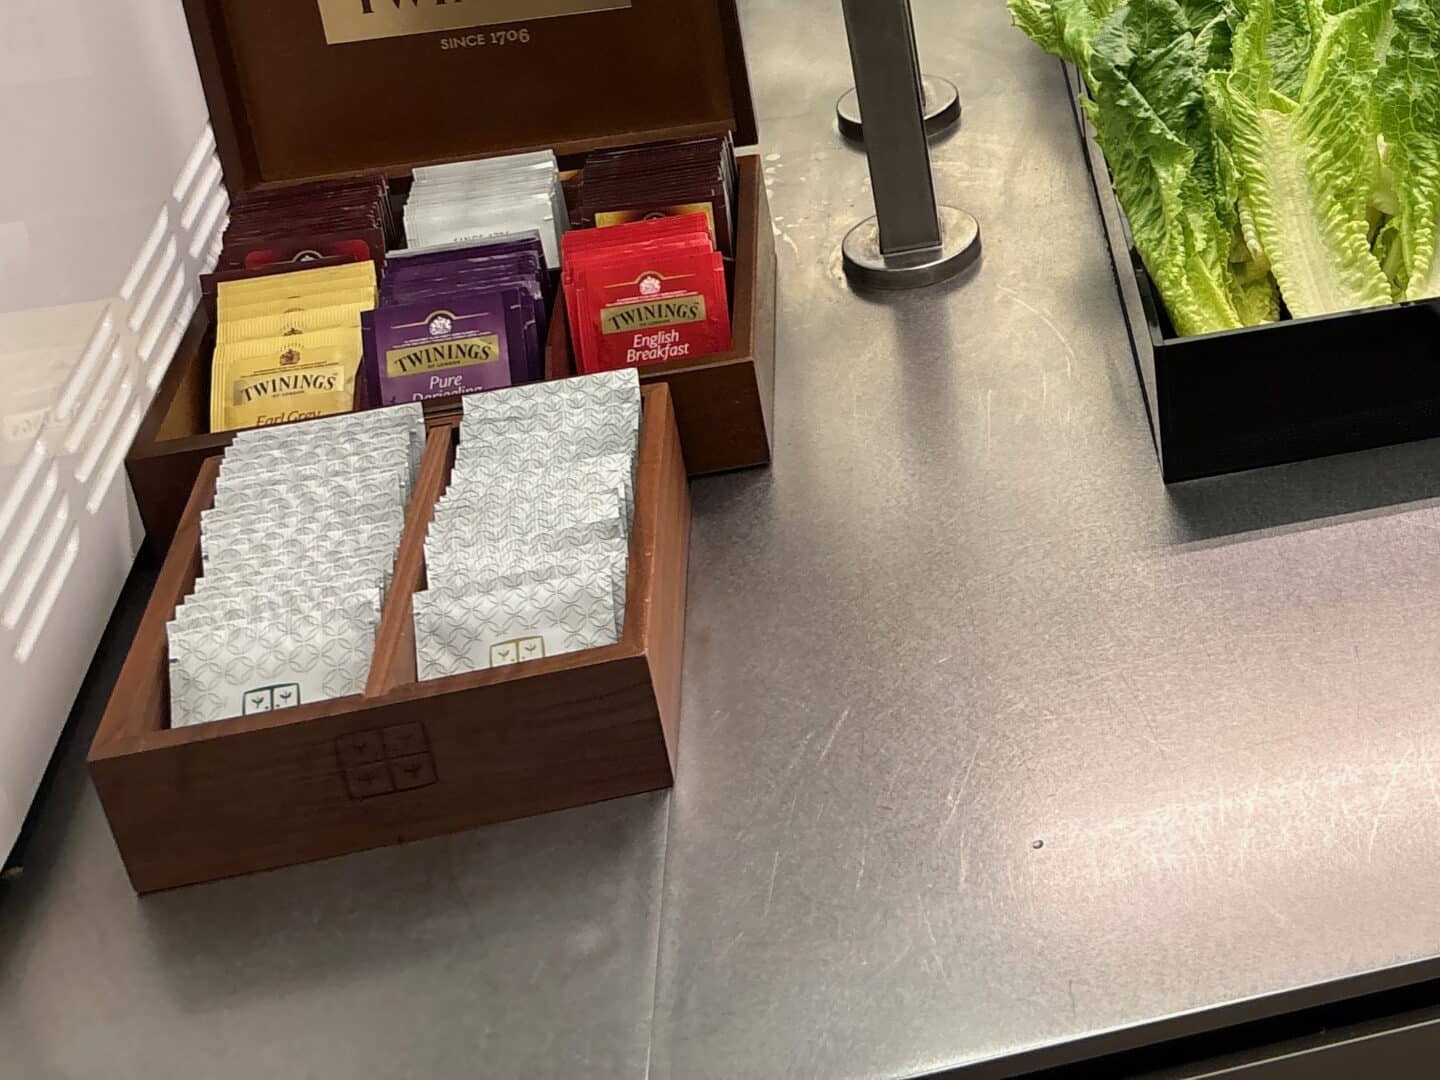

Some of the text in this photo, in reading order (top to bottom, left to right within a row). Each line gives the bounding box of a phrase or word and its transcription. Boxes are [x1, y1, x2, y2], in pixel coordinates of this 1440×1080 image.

[440, 28, 530, 50] SINCE 1706
[608, 302, 699, 331] TWININGS
[633, 328, 680, 348] English
[394, 342, 492, 373] TWININGS
[626, 343, 690, 363] Breakfast
[240, 373, 338, 402] TWININGS
[429, 375, 463, 390] Pure
